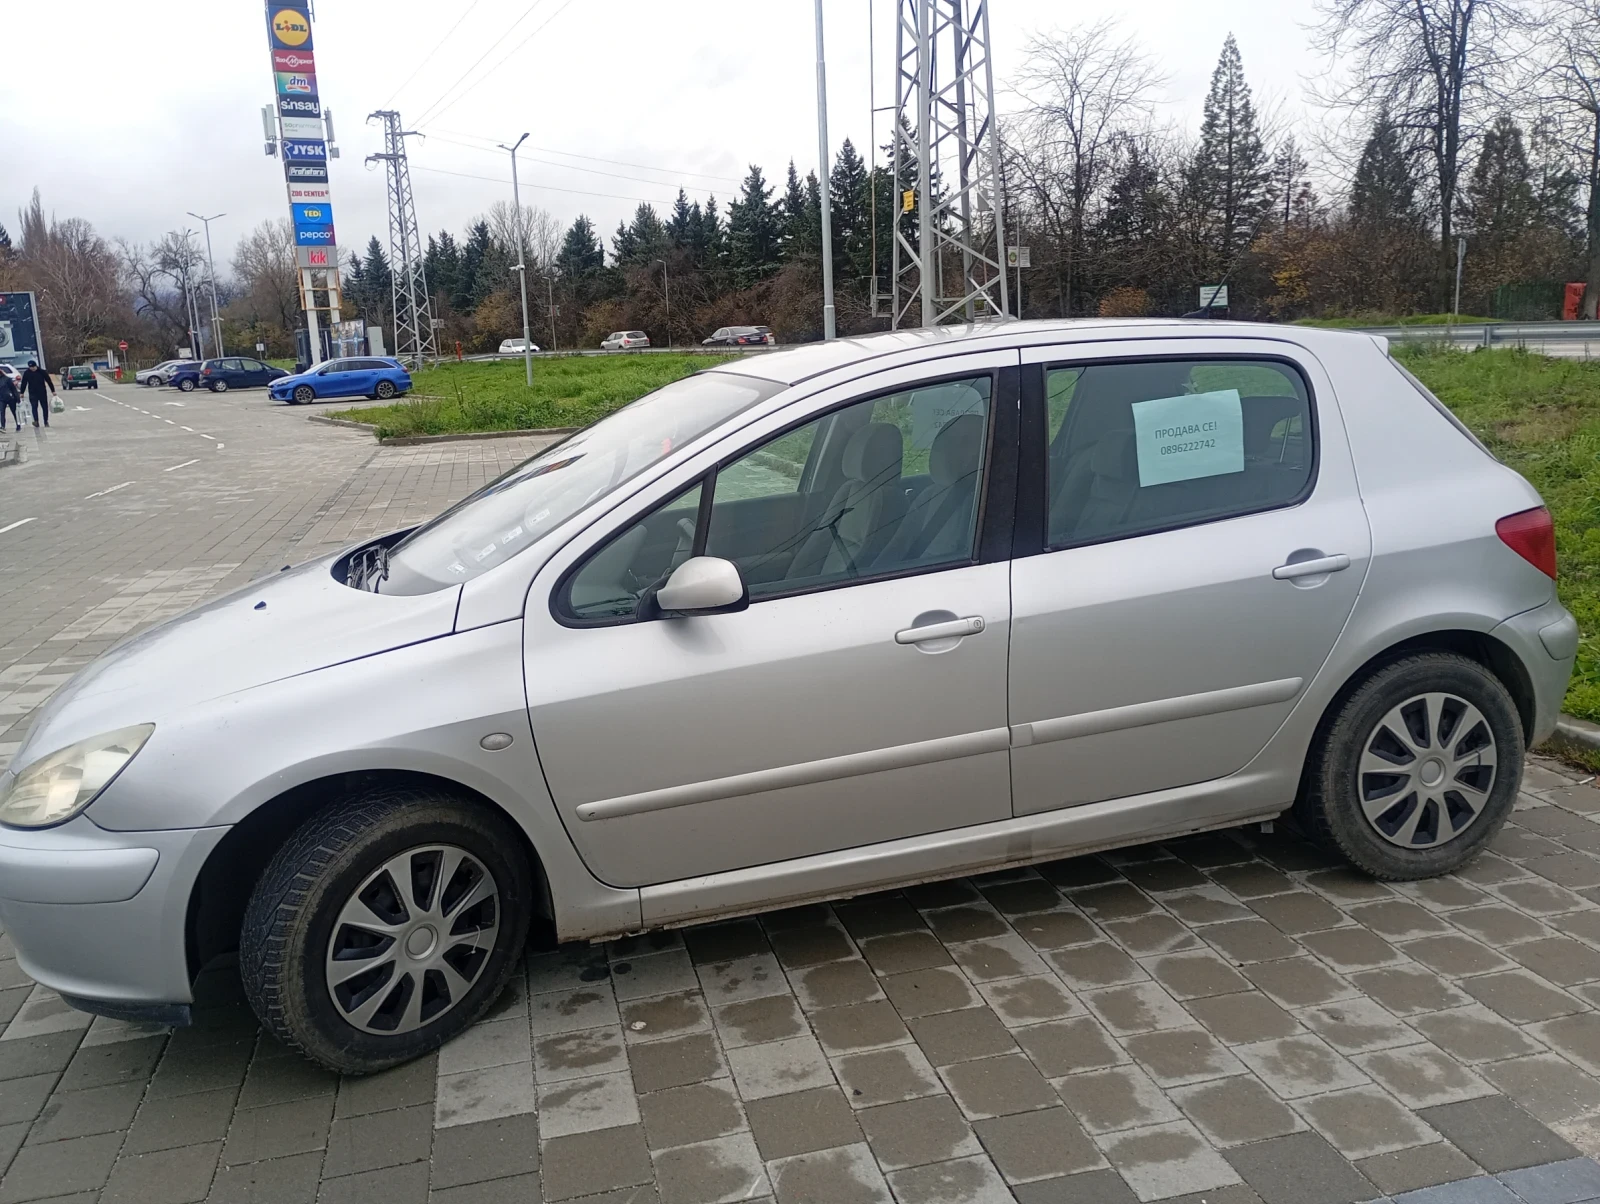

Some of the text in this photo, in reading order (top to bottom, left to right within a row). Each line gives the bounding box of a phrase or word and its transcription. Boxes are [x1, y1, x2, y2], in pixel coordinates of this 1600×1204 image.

[290, 76, 307, 86] dm
[281, 98, 319, 114] sinsay
[293, 145, 324, 156] JYSK
[300, 230, 331, 240] pepco
[1155, 421, 1217, 439] ПРОДАВА СЕ!
[1160, 439, 1216, 455] 0896222742
